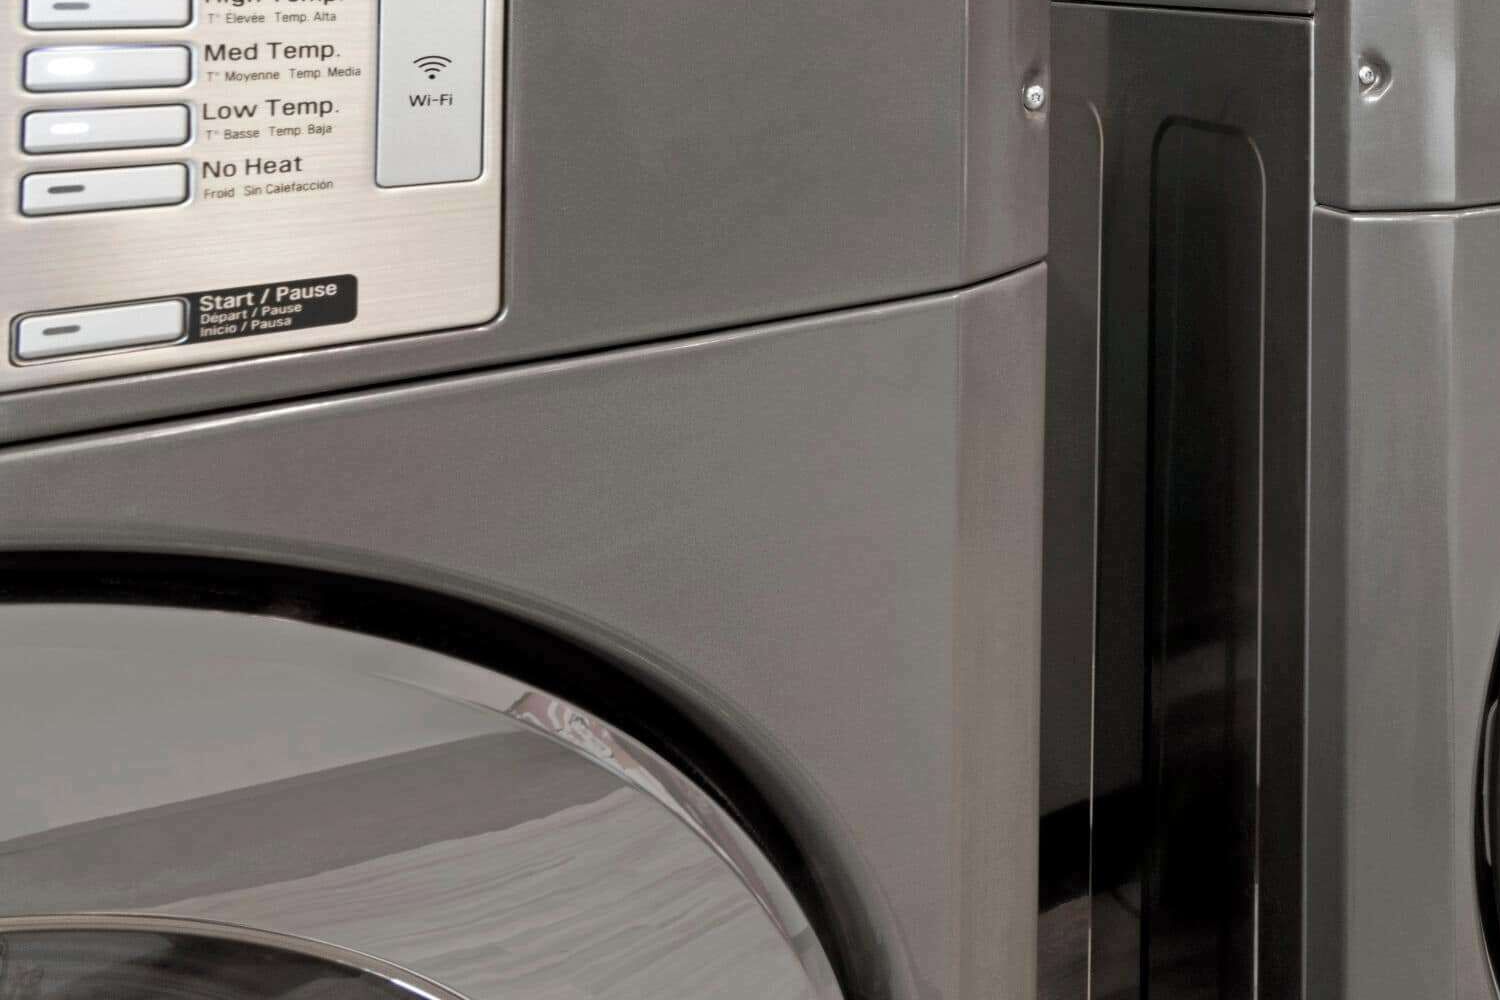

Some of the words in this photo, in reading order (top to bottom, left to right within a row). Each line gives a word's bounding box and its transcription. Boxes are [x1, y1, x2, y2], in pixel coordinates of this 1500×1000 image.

[313, 11, 337, 22] Alta
[204, 43, 258, 62] Med
[266, 42, 341, 62] Temp.
[225, 70, 280, 83] Moyenne
[327, 66, 362, 78] Media
[409, 94, 453, 107] Wi-Fi
[203, 103, 258, 120] Low
[265, 99, 340, 118] Temp.
[224, 128, 260, 140] Basse
[308, 124, 333, 136] Baja
[202, 160, 237, 179] No
[245, 156, 303, 175] Heat
[203, 187, 235, 200] Froid
[244, 184, 262, 197] Sin
[200, 292, 254, 312] Start
[260, 289, 270, 304] /
[276, 283, 338, 303] Pause
[261, 303, 303, 317] Pause
[200, 324, 237, 337] Inicio
[251, 317, 293, 331] Pausa
